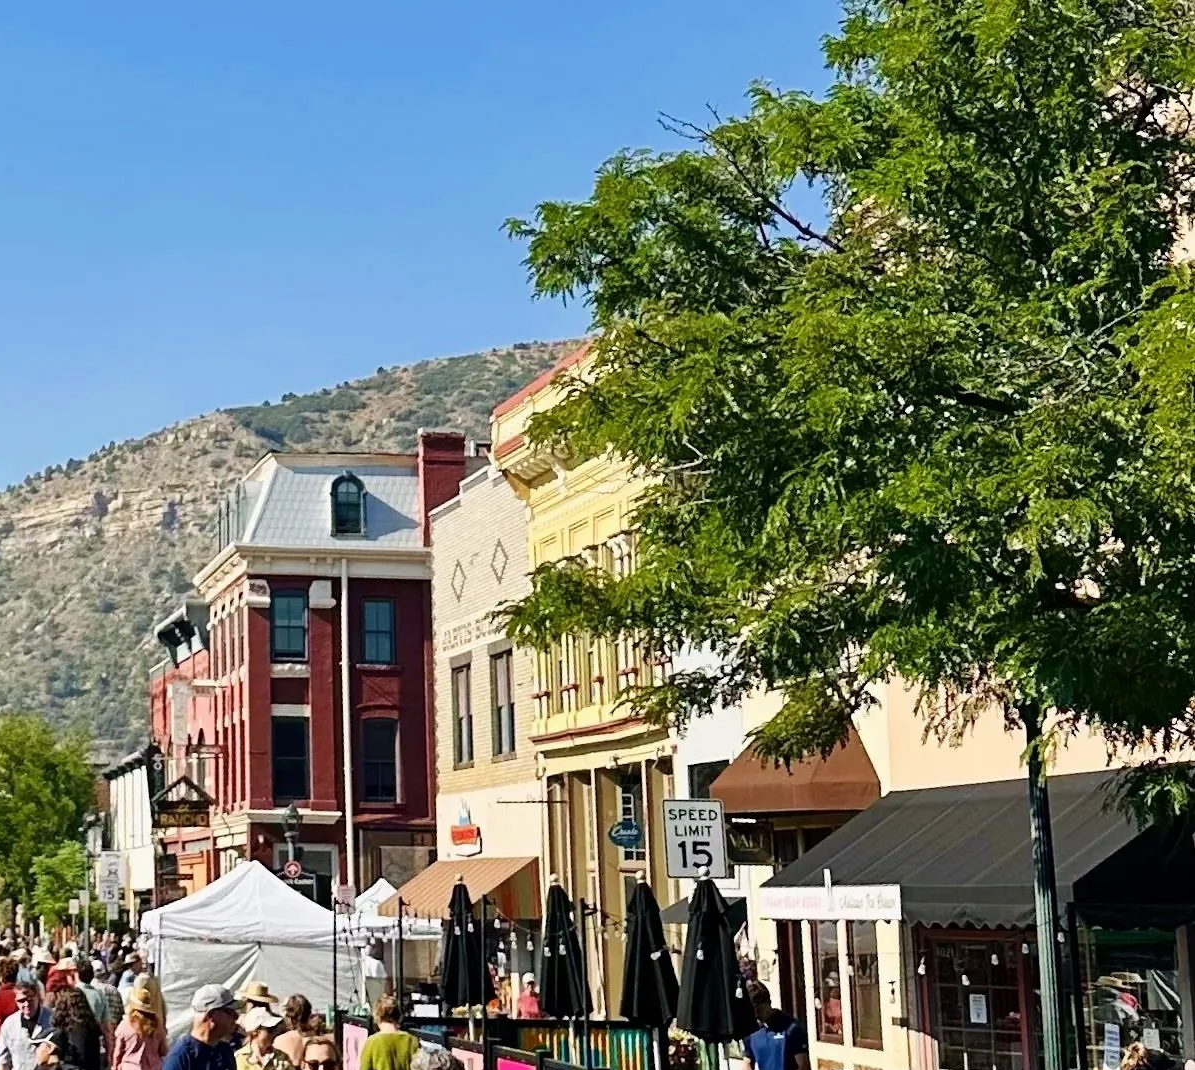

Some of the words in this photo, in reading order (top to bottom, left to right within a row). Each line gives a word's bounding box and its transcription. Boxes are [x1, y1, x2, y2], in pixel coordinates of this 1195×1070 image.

[160, 813, 208, 826] RANCHO
[668, 808, 718, 821] SPEED
[674, 825, 713, 837] LIMIT
[677, 840, 713, 869] 15
